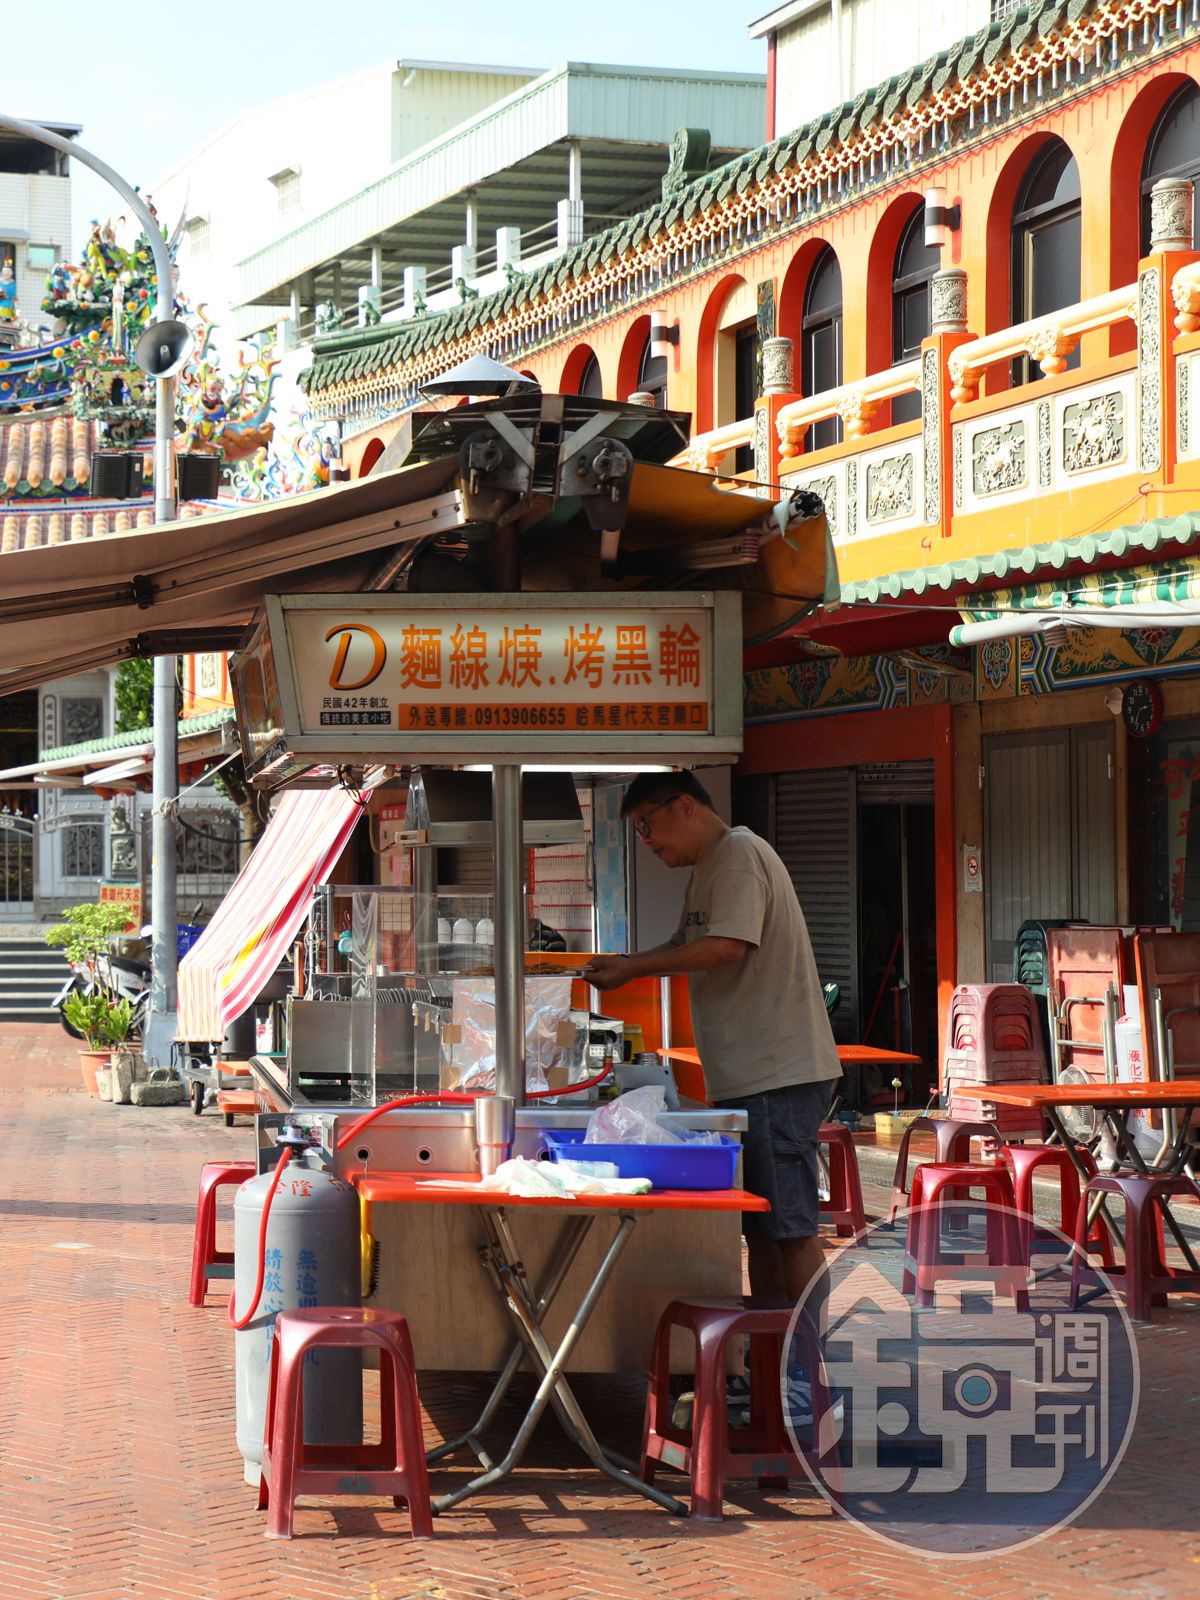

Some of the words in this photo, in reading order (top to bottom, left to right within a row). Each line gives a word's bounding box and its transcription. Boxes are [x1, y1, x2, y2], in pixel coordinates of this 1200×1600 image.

[323, 697, 389, 709] 民國42年創立
[322, 712, 392, 725] 傳統的美食小吃
[576, 704, 702, 726] 哈馬星代天宮廟口
